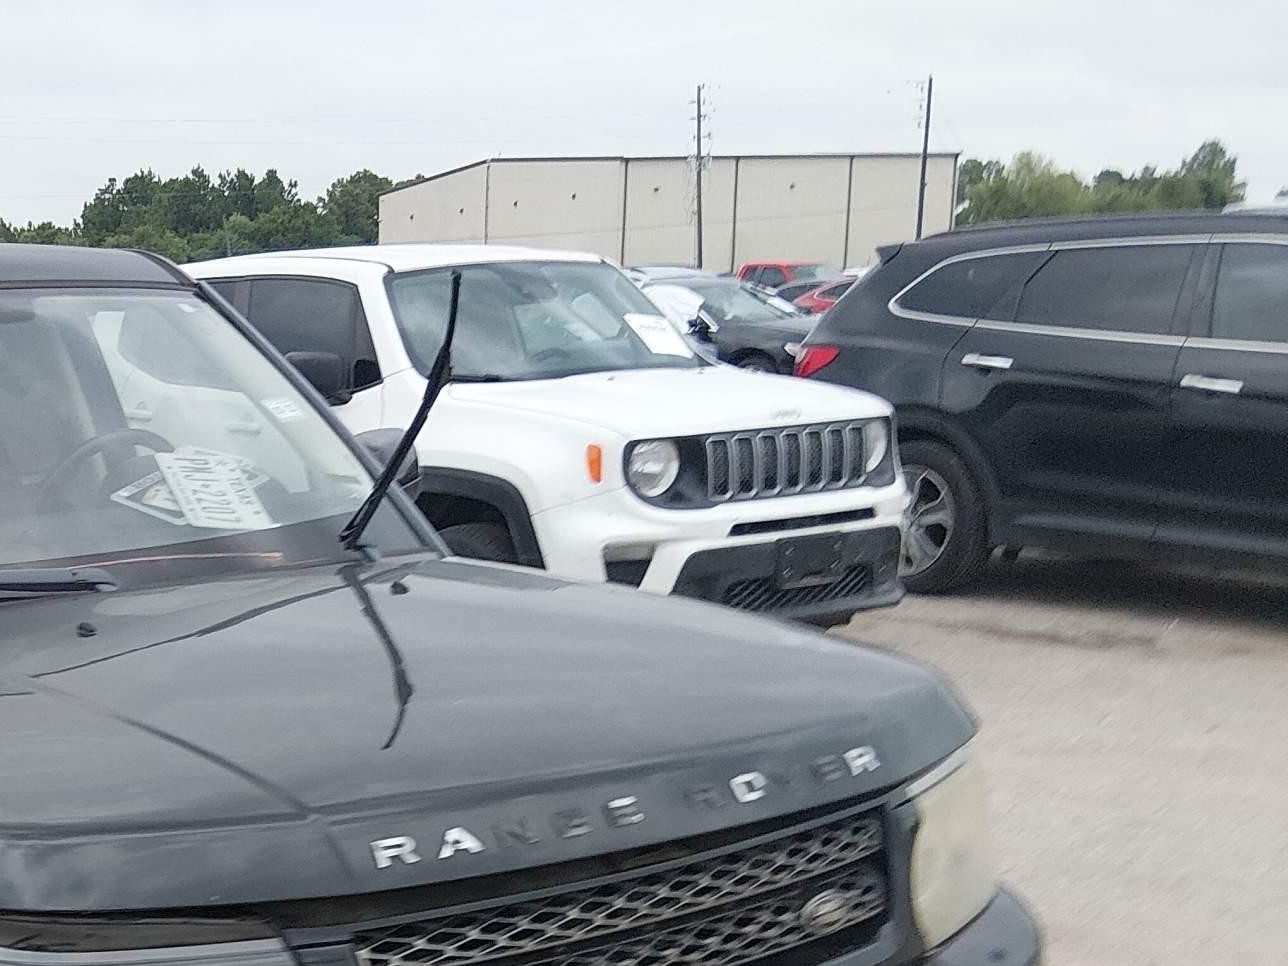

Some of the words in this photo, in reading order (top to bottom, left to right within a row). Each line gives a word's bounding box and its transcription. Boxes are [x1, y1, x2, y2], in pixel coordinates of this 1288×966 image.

[226, 477, 253, 505] TEXAS
[369, 796, 645, 869] RANGE
[683, 745, 881, 808] ROER
